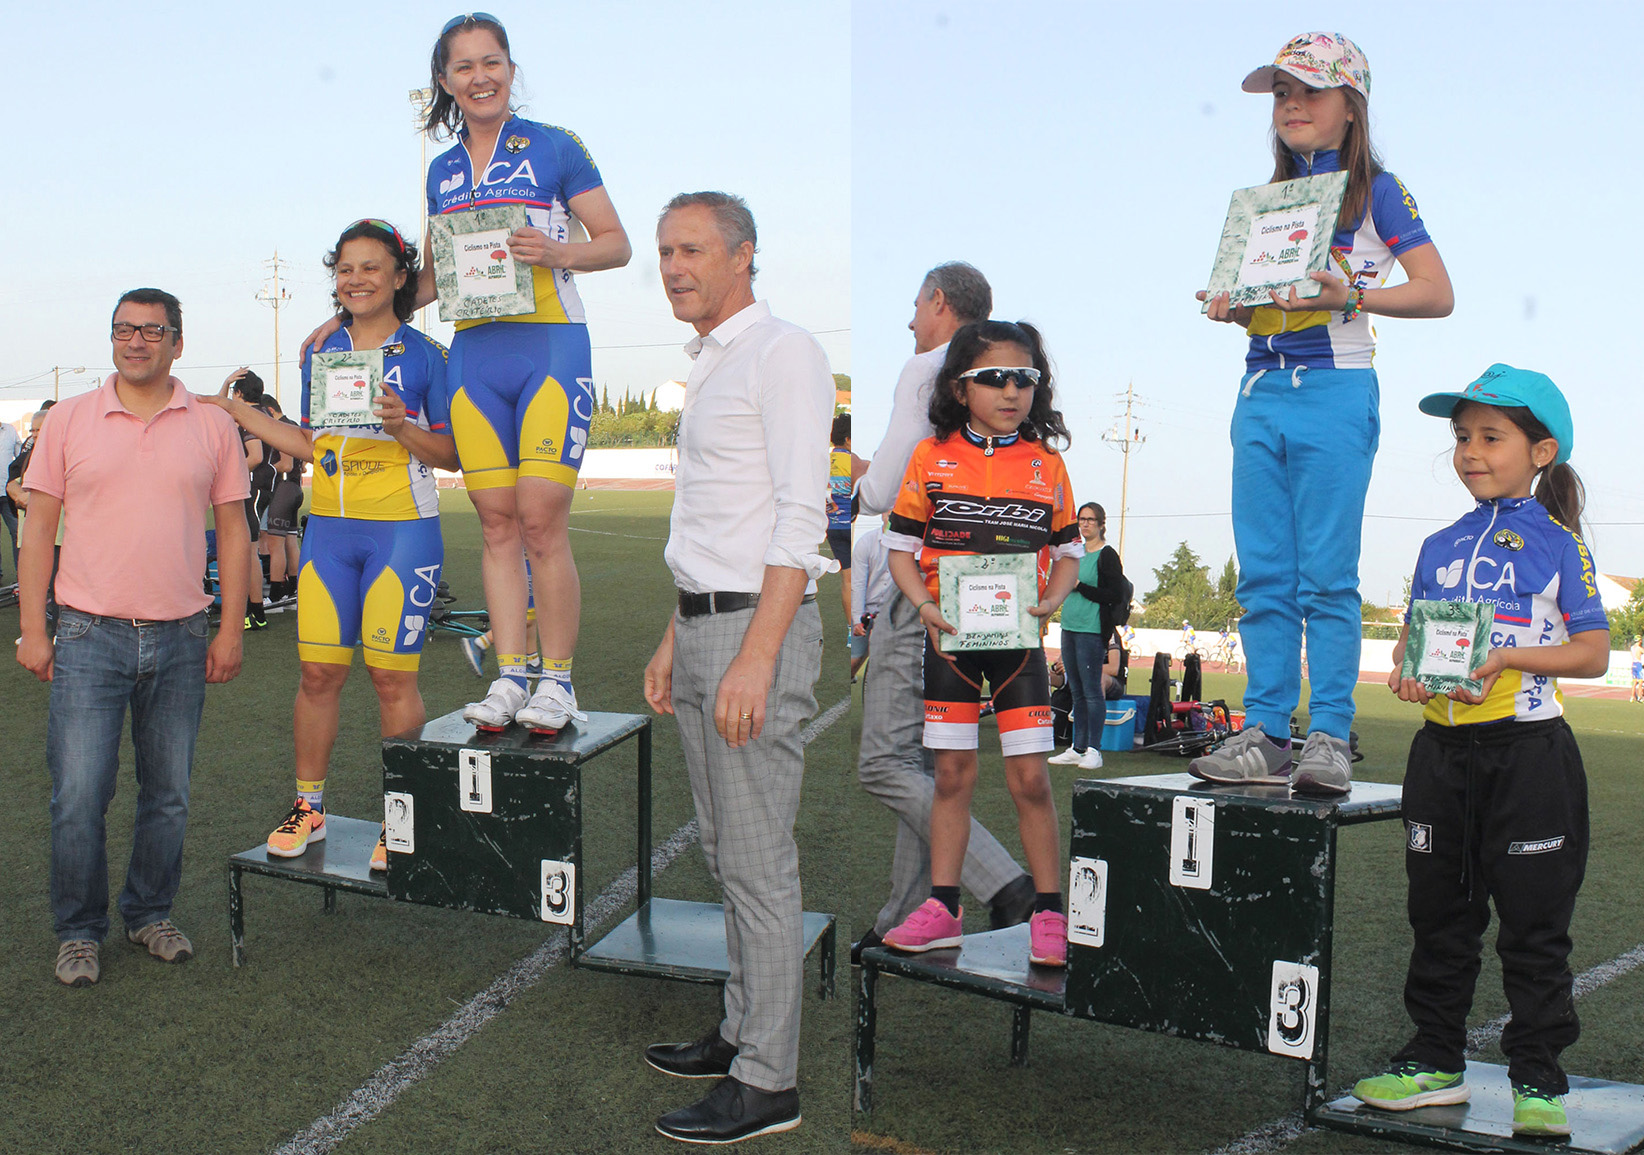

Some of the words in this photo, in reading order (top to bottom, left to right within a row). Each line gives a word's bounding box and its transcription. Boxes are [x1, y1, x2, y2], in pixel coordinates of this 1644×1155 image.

[483, 159, 539, 188] CA
[485, 187, 536, 198] Agrícola
[464, 243, 483, 252] Ciclismo
[489, 241, 501, 249] Pista
[1261, 224, 1282, 235] Ciclismo
[1283, 223, 1291, 231] na
[1291, 221, 1305, 230] Pista
[573, 377, 594, 422] CA
[409, 563, 440, 607] CA
[1470, 556, 1516, 594] CA
[468, 756, 483, 805] 1
[1181, 806, 1199, 877] 1
[1523, 838, 1563, 852] MERCURY
[546, 869, 571, 917] 3
[1276, 974, 1311, 1047] 3
